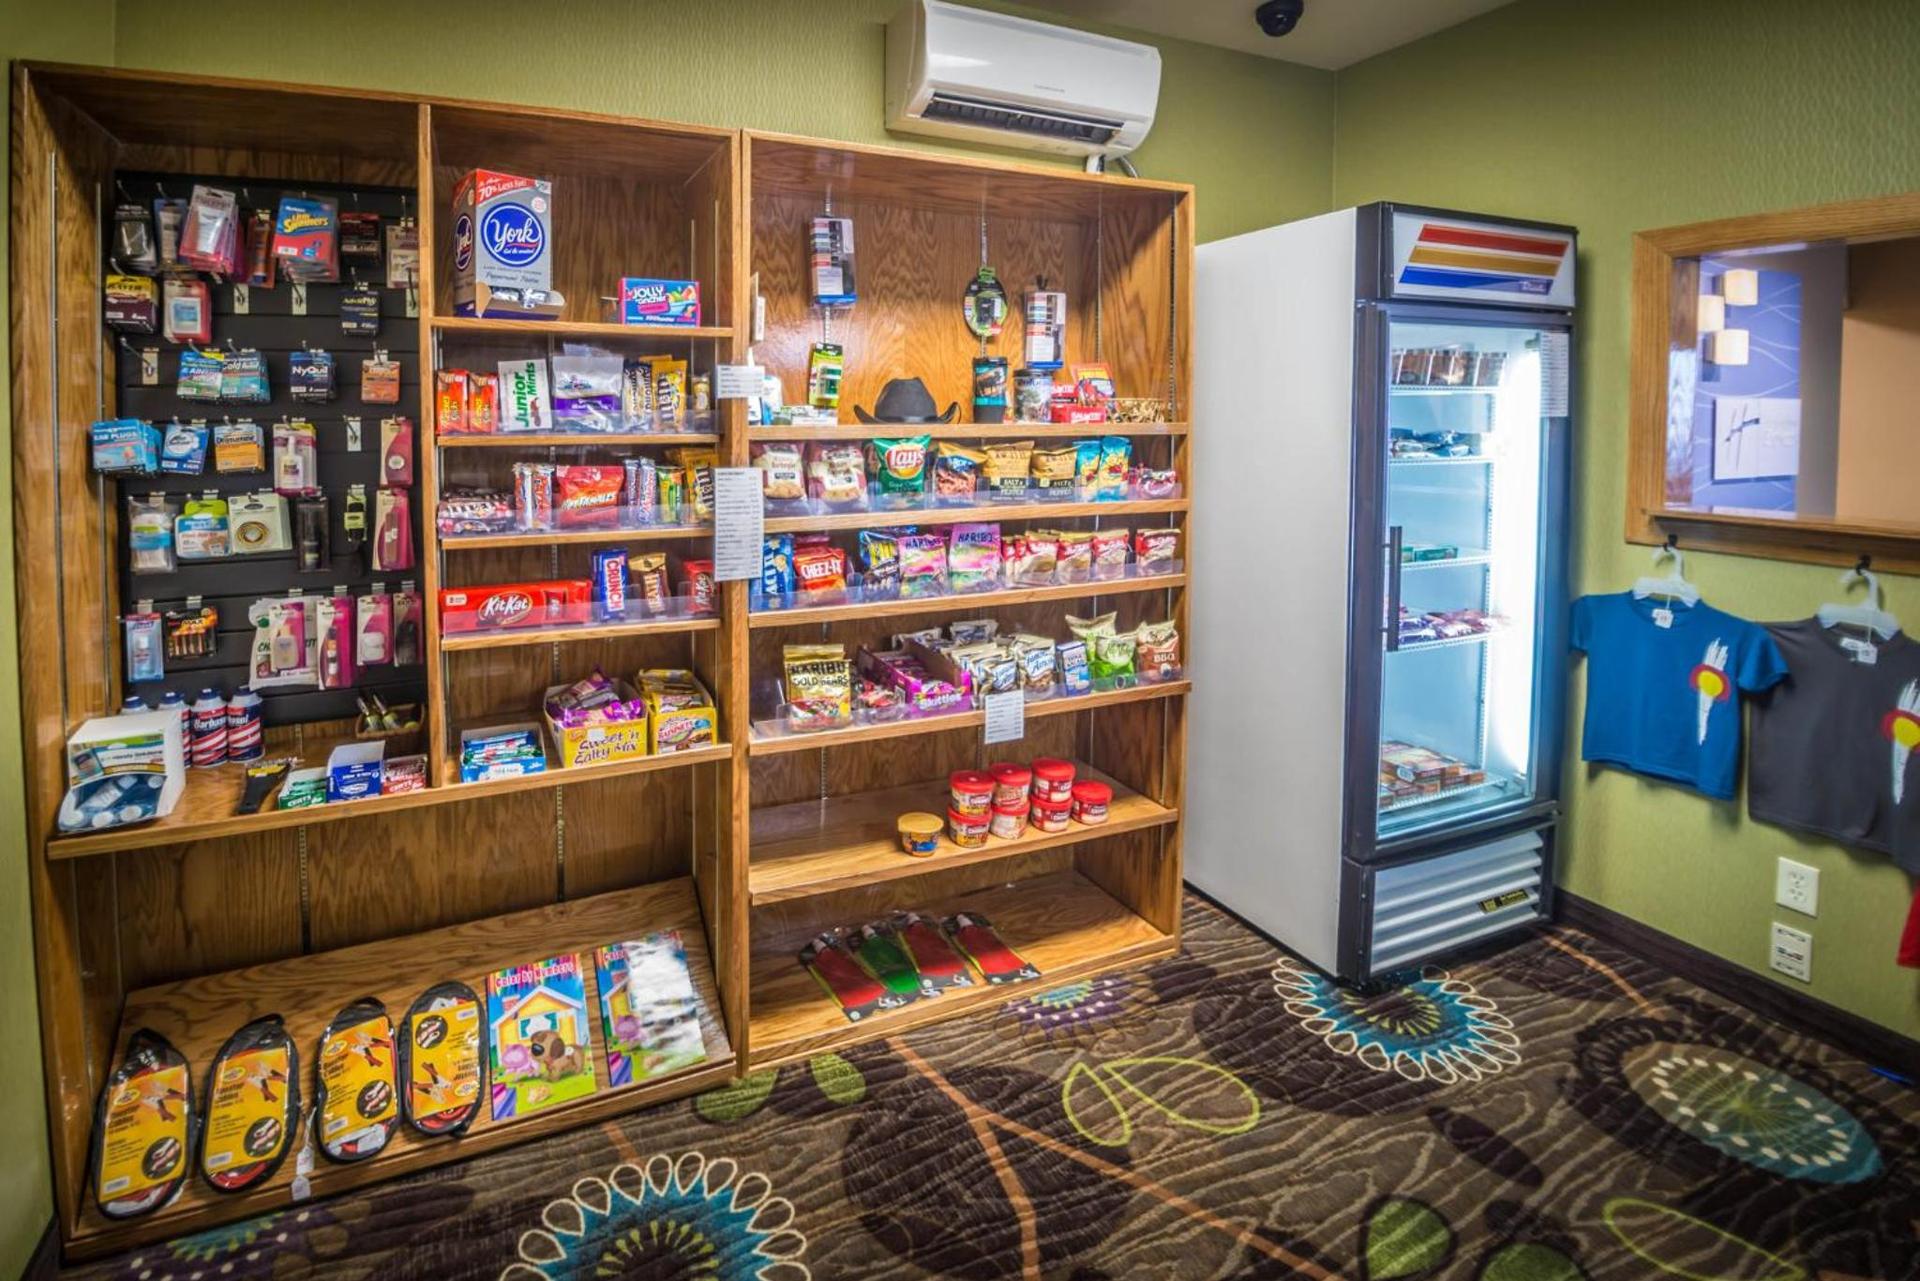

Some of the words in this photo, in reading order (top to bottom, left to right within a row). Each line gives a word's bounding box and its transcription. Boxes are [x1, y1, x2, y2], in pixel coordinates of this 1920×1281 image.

[490, 217, 542, 253] York
[632, 285, 664, 299] JOLLY
[291, 365, 328, 376] NyQuil
[526, 361, 538, 396] Mints
[513, 371, 530, 428] Junior
[957, 531, 993, 543] HARIBO
[801, 558, 842, 580] CHEEZ-IT
[606, 559, 623, 609] CRUNCH
[484, 594, 528, 617] KitKat
[1153, 652, 1176, 663] BBQ
[790, 661, 846, 675] HARIBO
[579, 732, 623, 750] Sweet
[574, 747, 610, 764] Salty
[496, 974, 521, 988] Color
